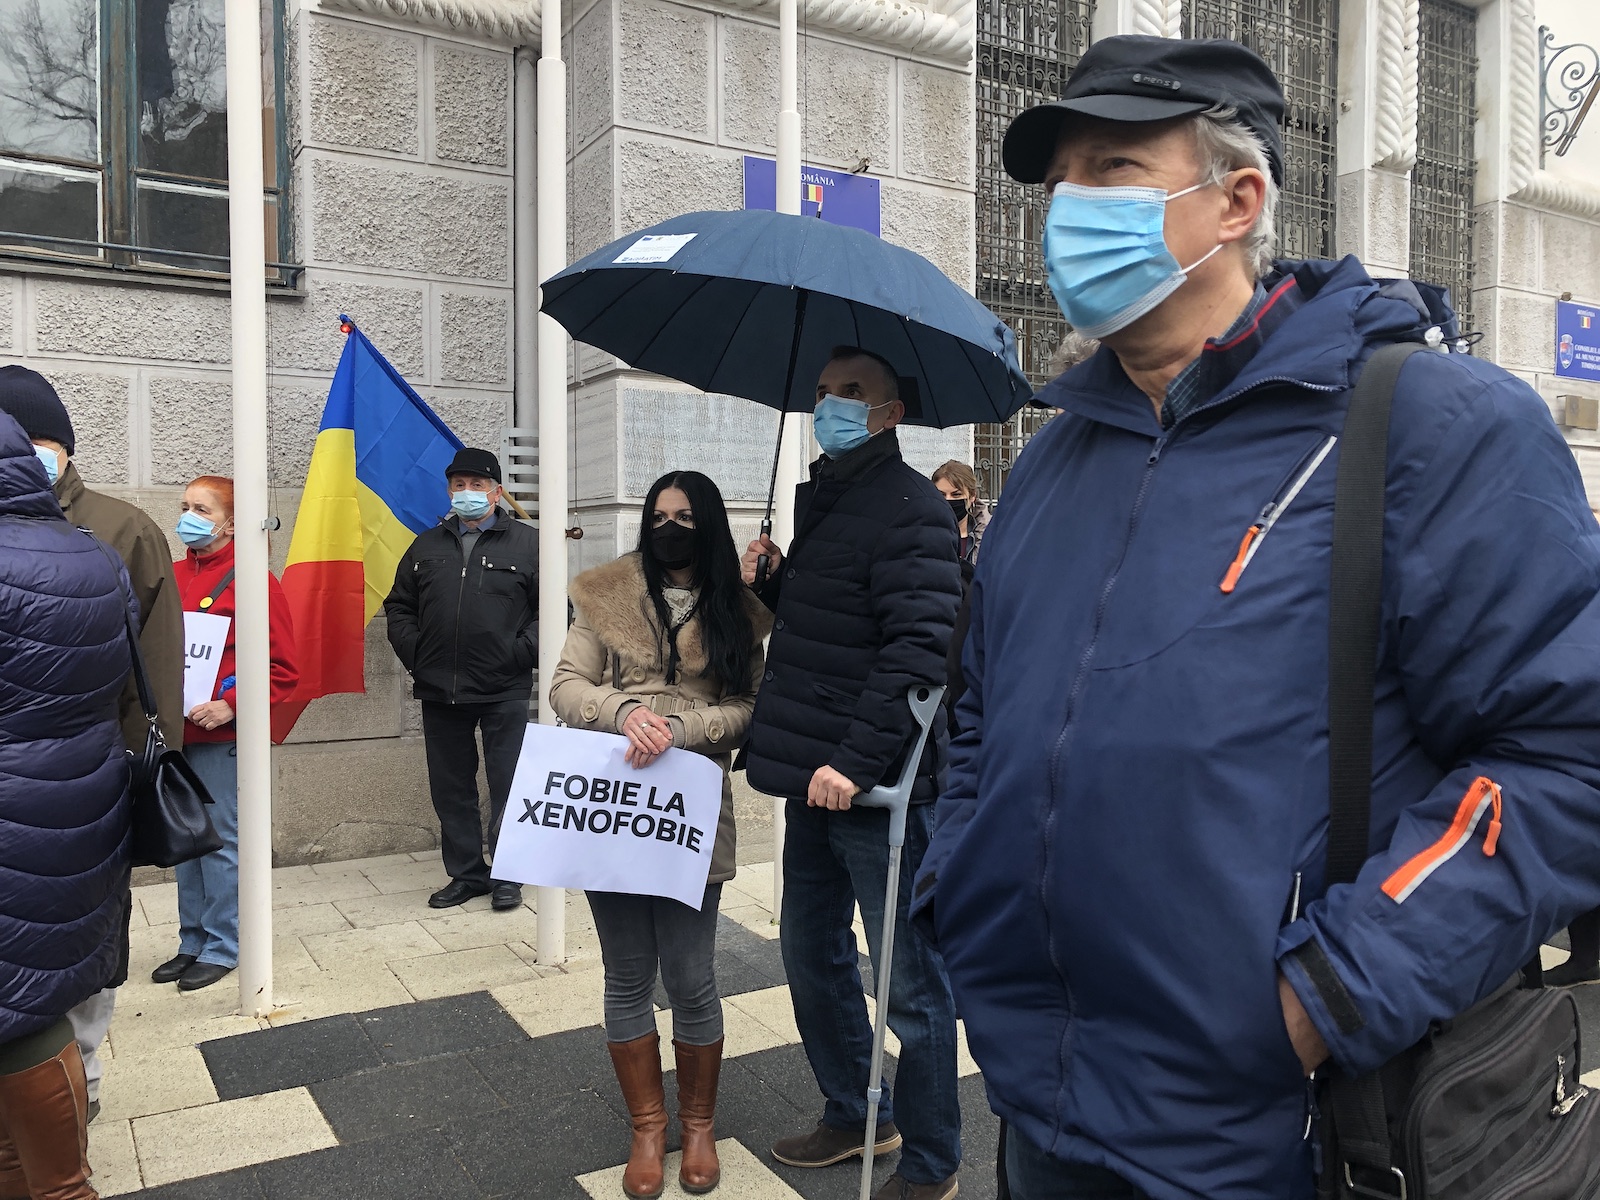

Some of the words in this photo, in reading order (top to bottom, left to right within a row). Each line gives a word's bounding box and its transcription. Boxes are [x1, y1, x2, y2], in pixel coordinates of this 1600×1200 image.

[801, 173, 835, 187] OMÂNIA
[185, 643, 212, 661] UI
[544, 771, 641, 807] FOBIE
[647, 786, 686, 817] LA
[517, 798, 704, 853] XENOFOBIE
